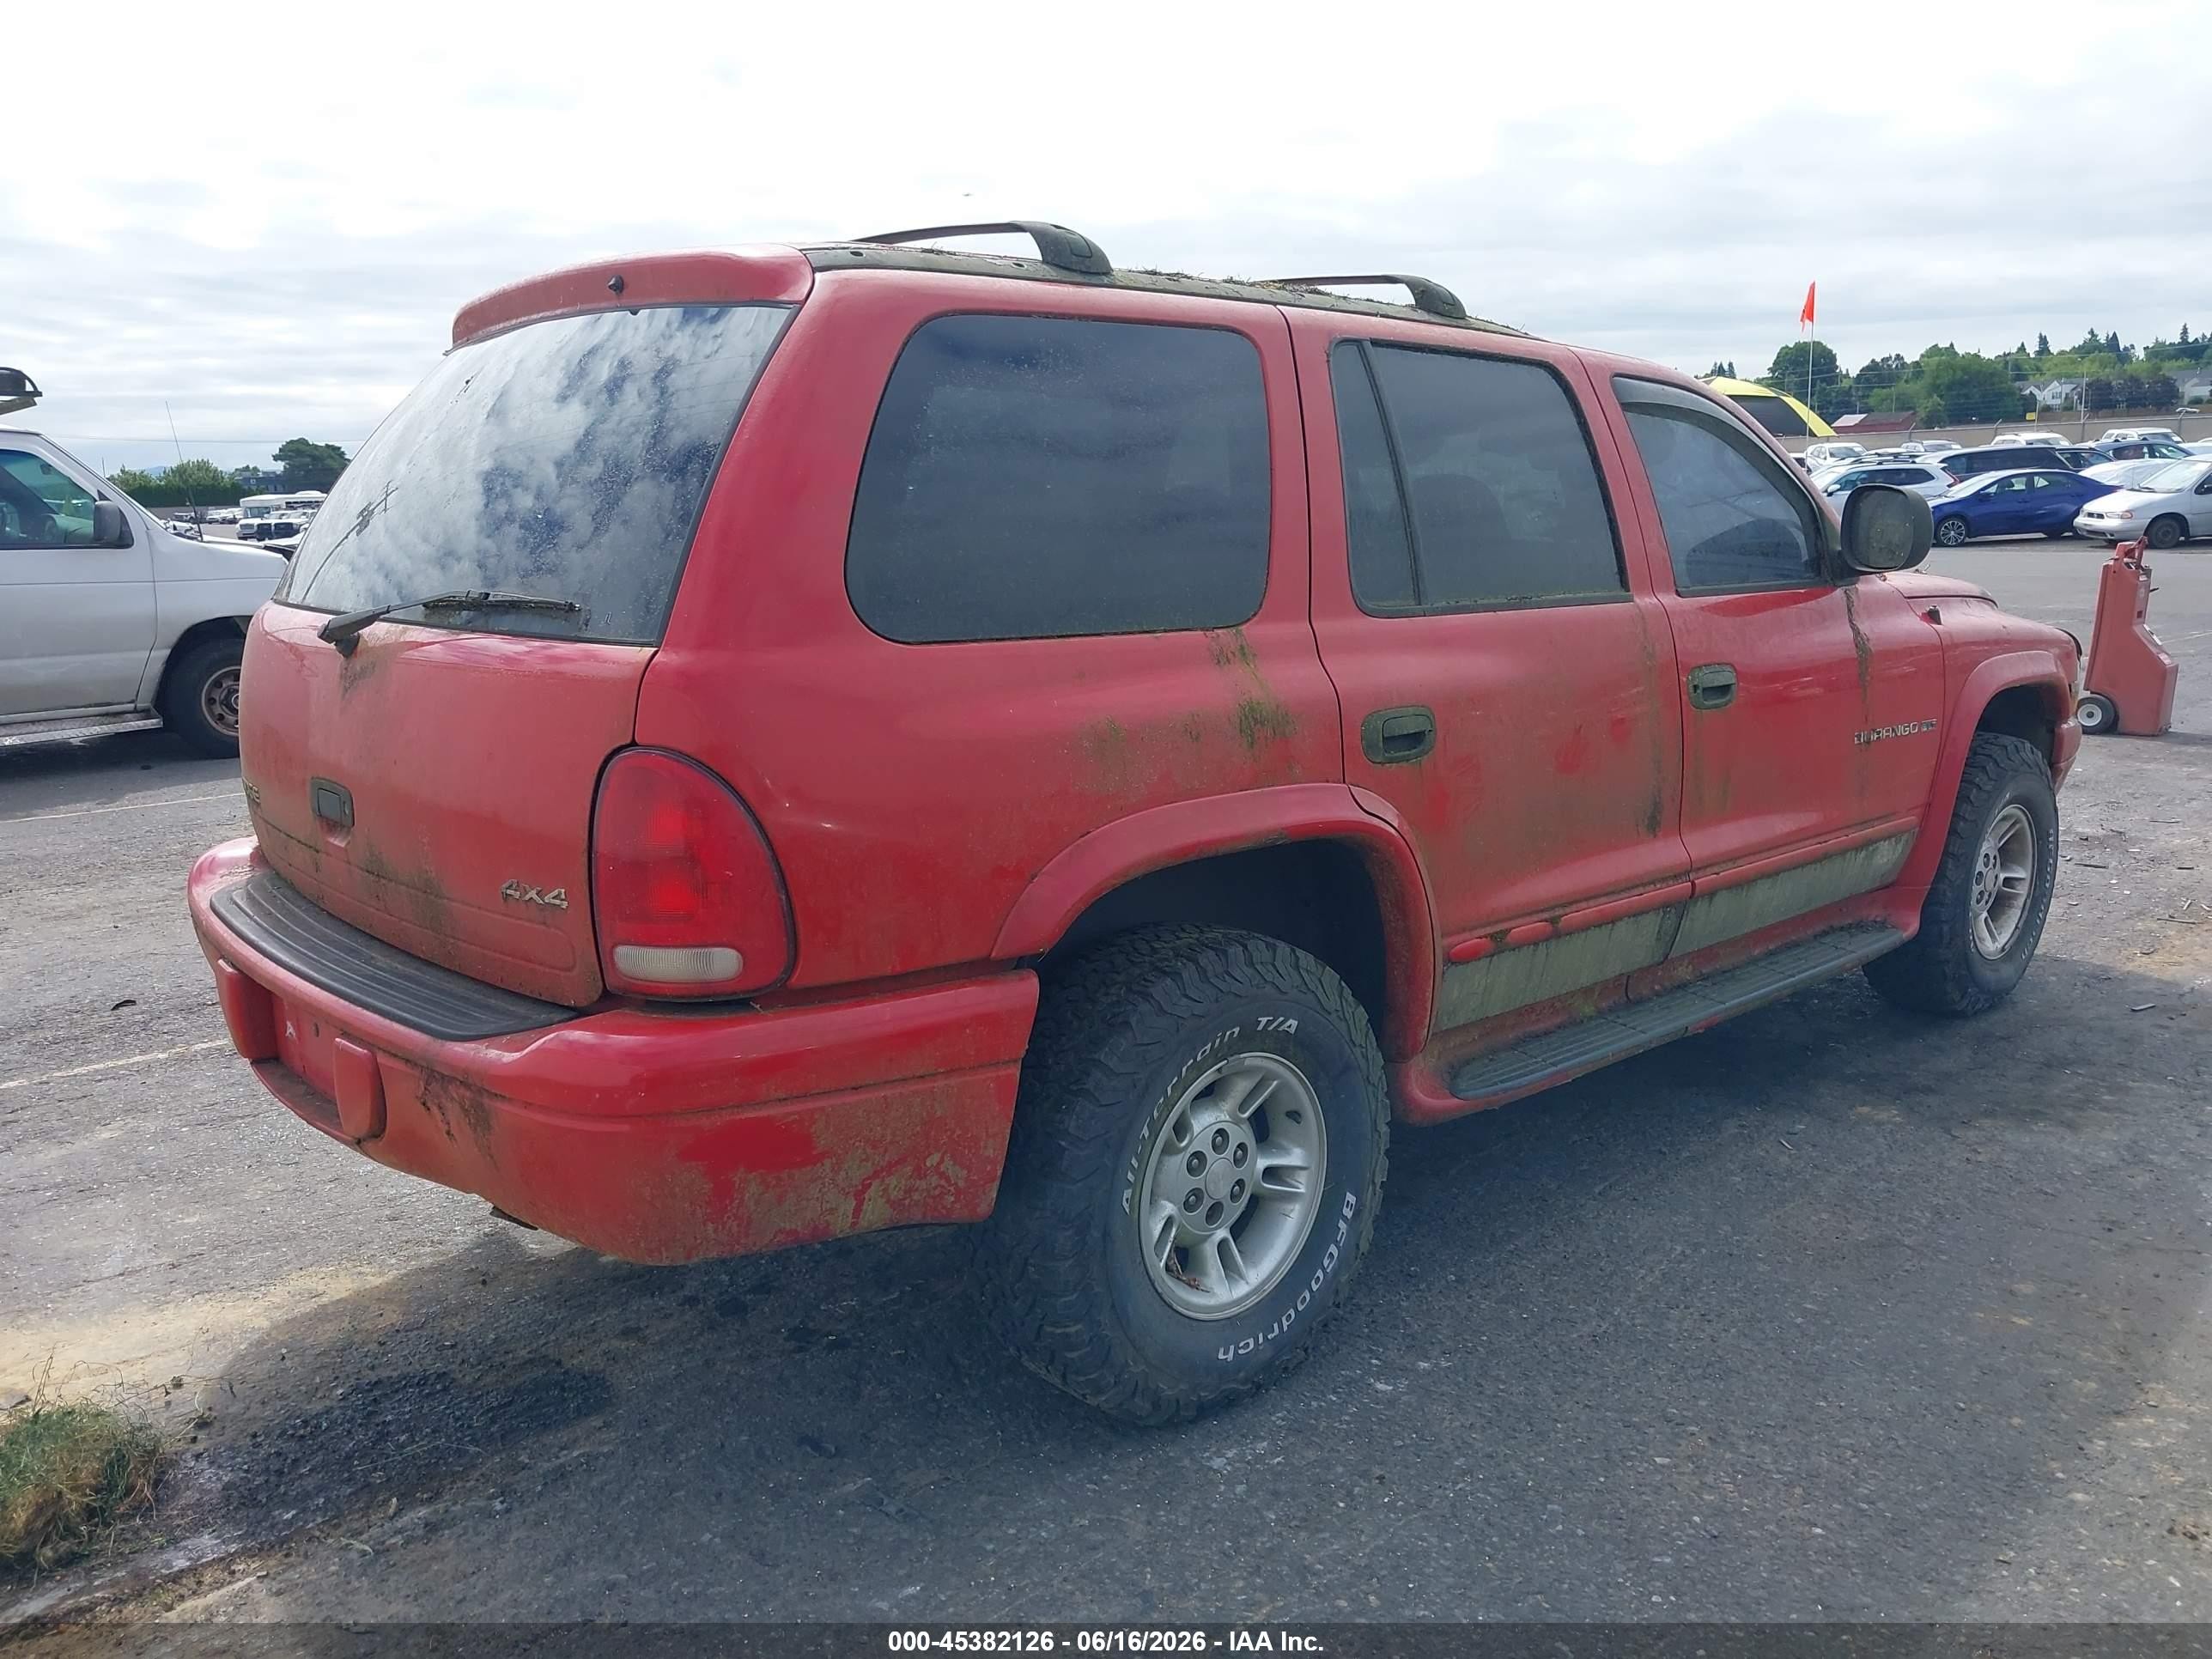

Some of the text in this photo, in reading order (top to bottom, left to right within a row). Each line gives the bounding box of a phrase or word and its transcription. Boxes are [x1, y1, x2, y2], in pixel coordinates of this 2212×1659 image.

[1854, 721, 1918, 744] DURANGO
[1121, 1017, 1299, 1216] All-Terrain T/A
[1217, 1191, 1357, 1362] BFGoodrich
